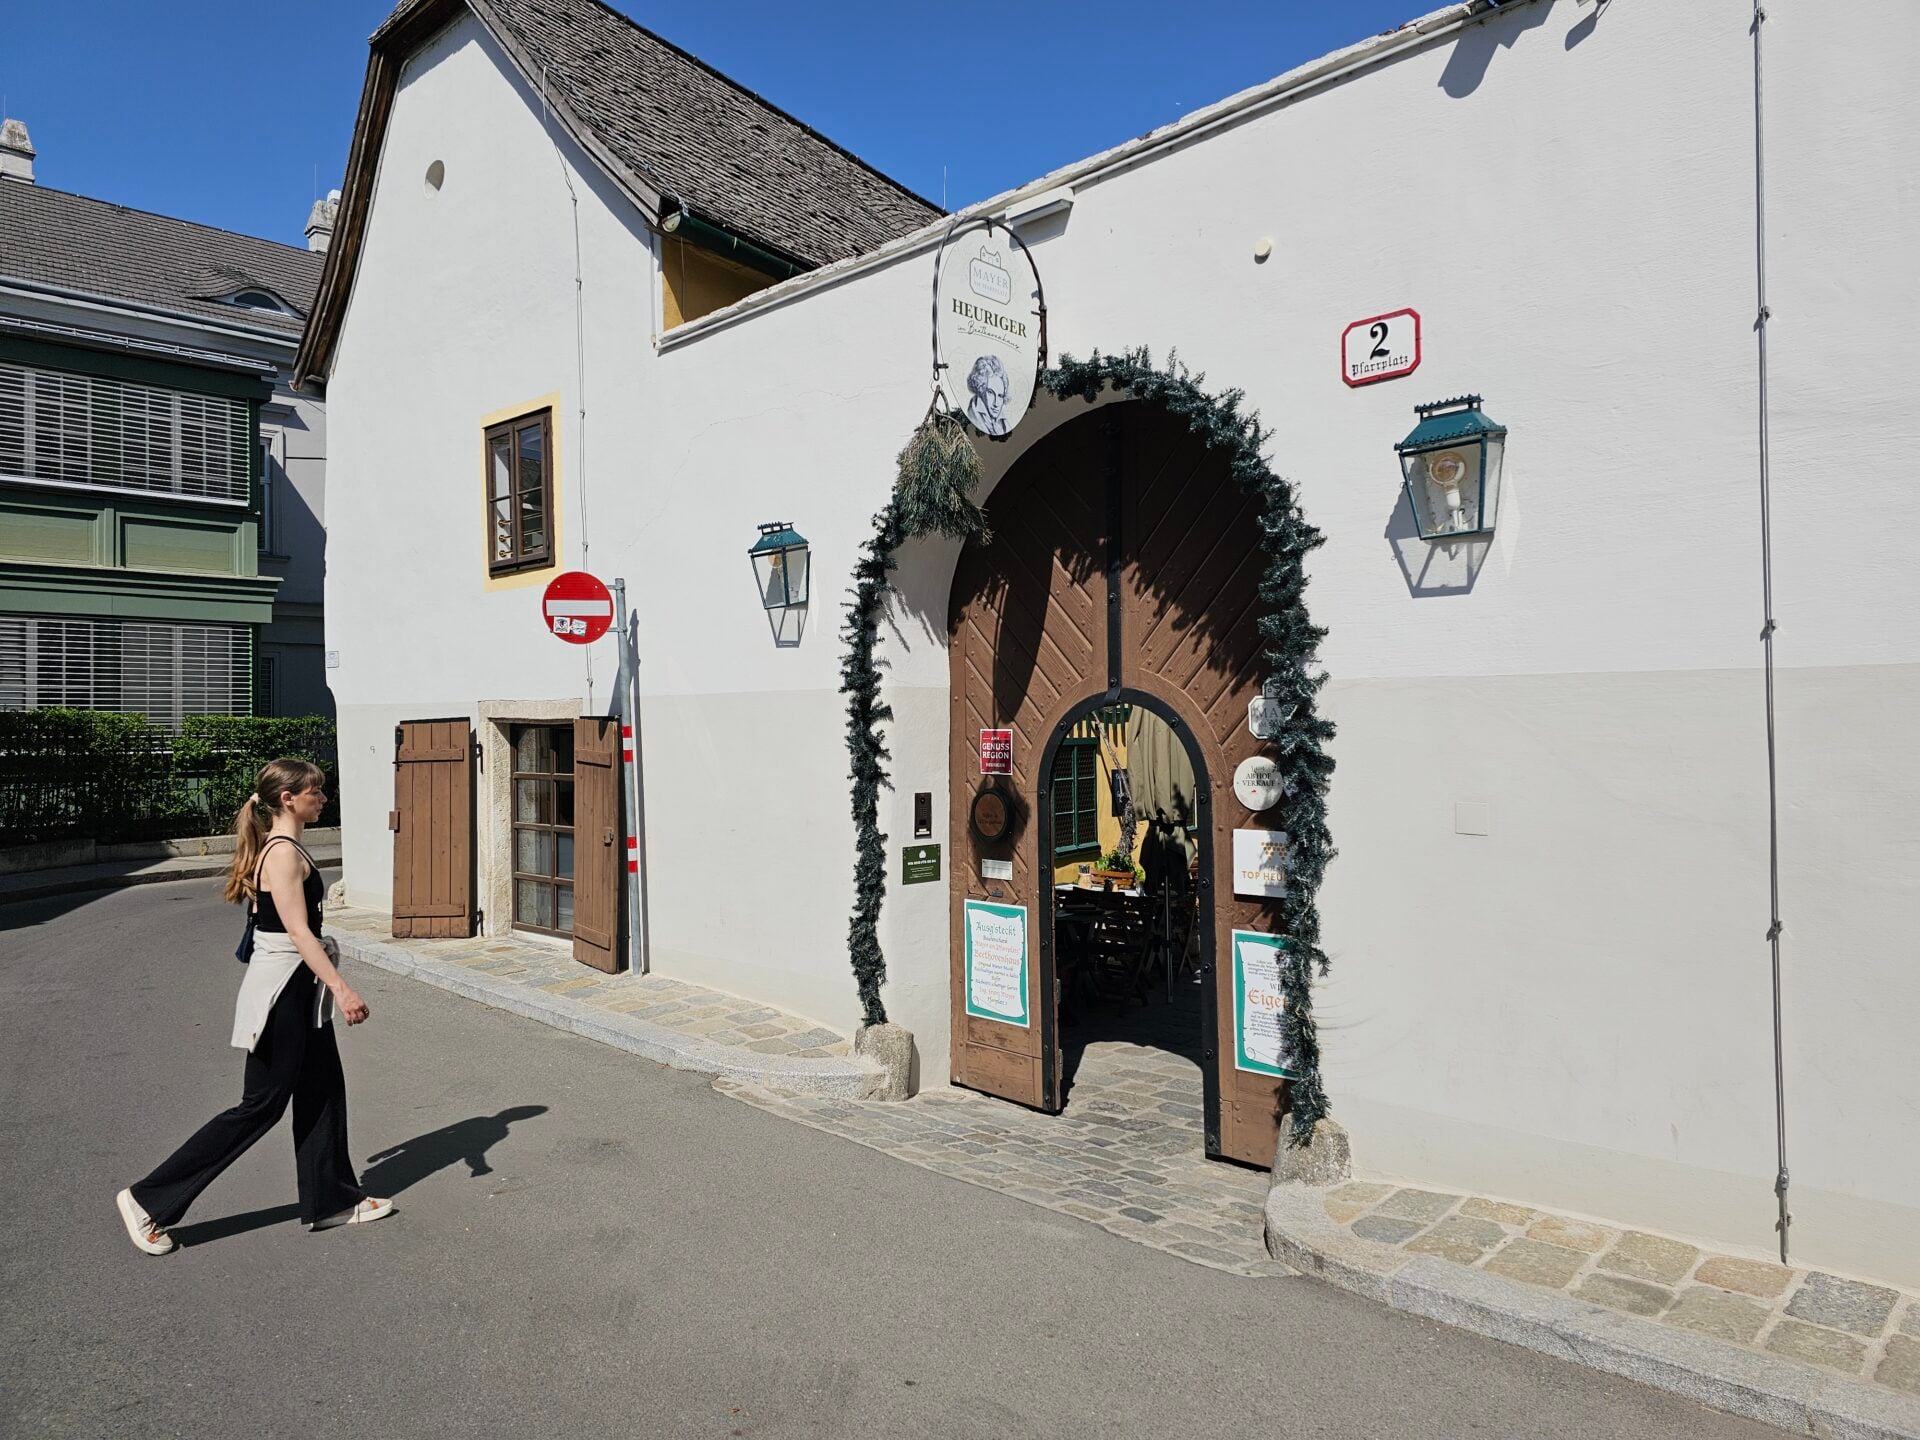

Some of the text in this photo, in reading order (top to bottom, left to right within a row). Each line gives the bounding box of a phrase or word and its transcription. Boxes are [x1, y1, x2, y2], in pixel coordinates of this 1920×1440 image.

[973, 266, 1009, 289] MAYER
[952, 298, 1027, 338] HEURIGER
[1370, 322, 1390, 360] 2
[1352, 355, 1408, 377] Pfarrplatz
[1256, 707, 1279, 718] MA
[982, 742, 1010, 751] GENUSS
[982, 751, 1009, 759] REGION
[1242, 779, 1276, 787] VERKAUF
[1241, 870, 1286, 882] TOP HEU
